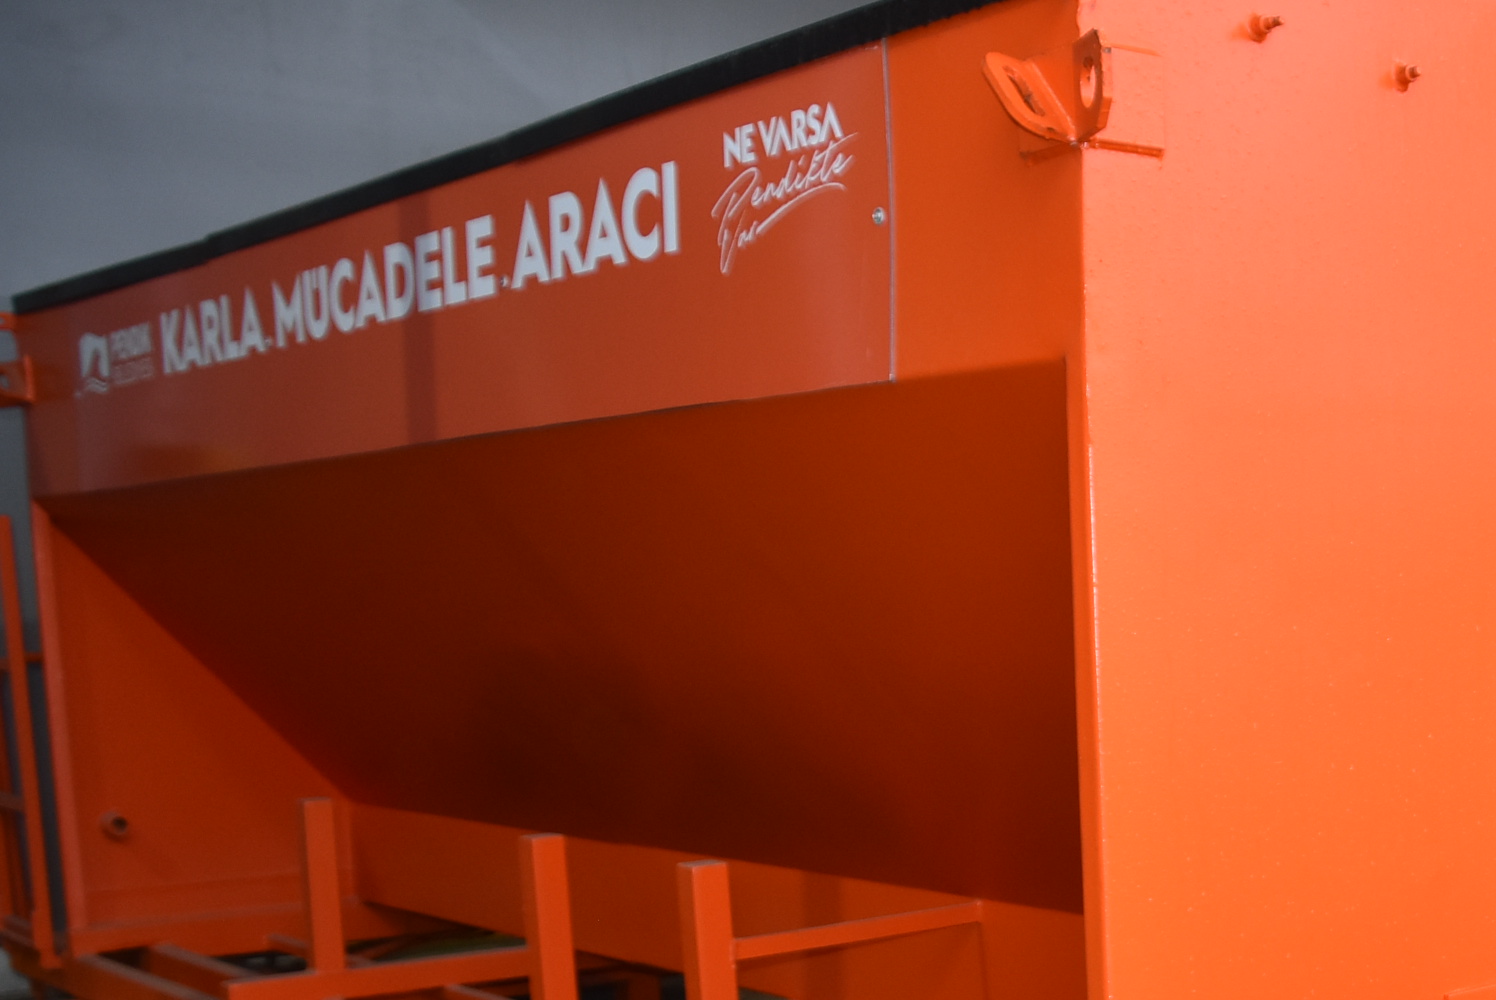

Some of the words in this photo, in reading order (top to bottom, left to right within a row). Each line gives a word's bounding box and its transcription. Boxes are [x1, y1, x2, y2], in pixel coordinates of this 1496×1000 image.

[711, 132, 858, 246] Pendikte
[722, 123, 757, 169] NE
[757, 101, 844, 157] VARSA
[159, 286, 267, 375] KARLA
[272, 214, 497, 348] MÜCADELE
[510, 160, 680, 291] ARACI
